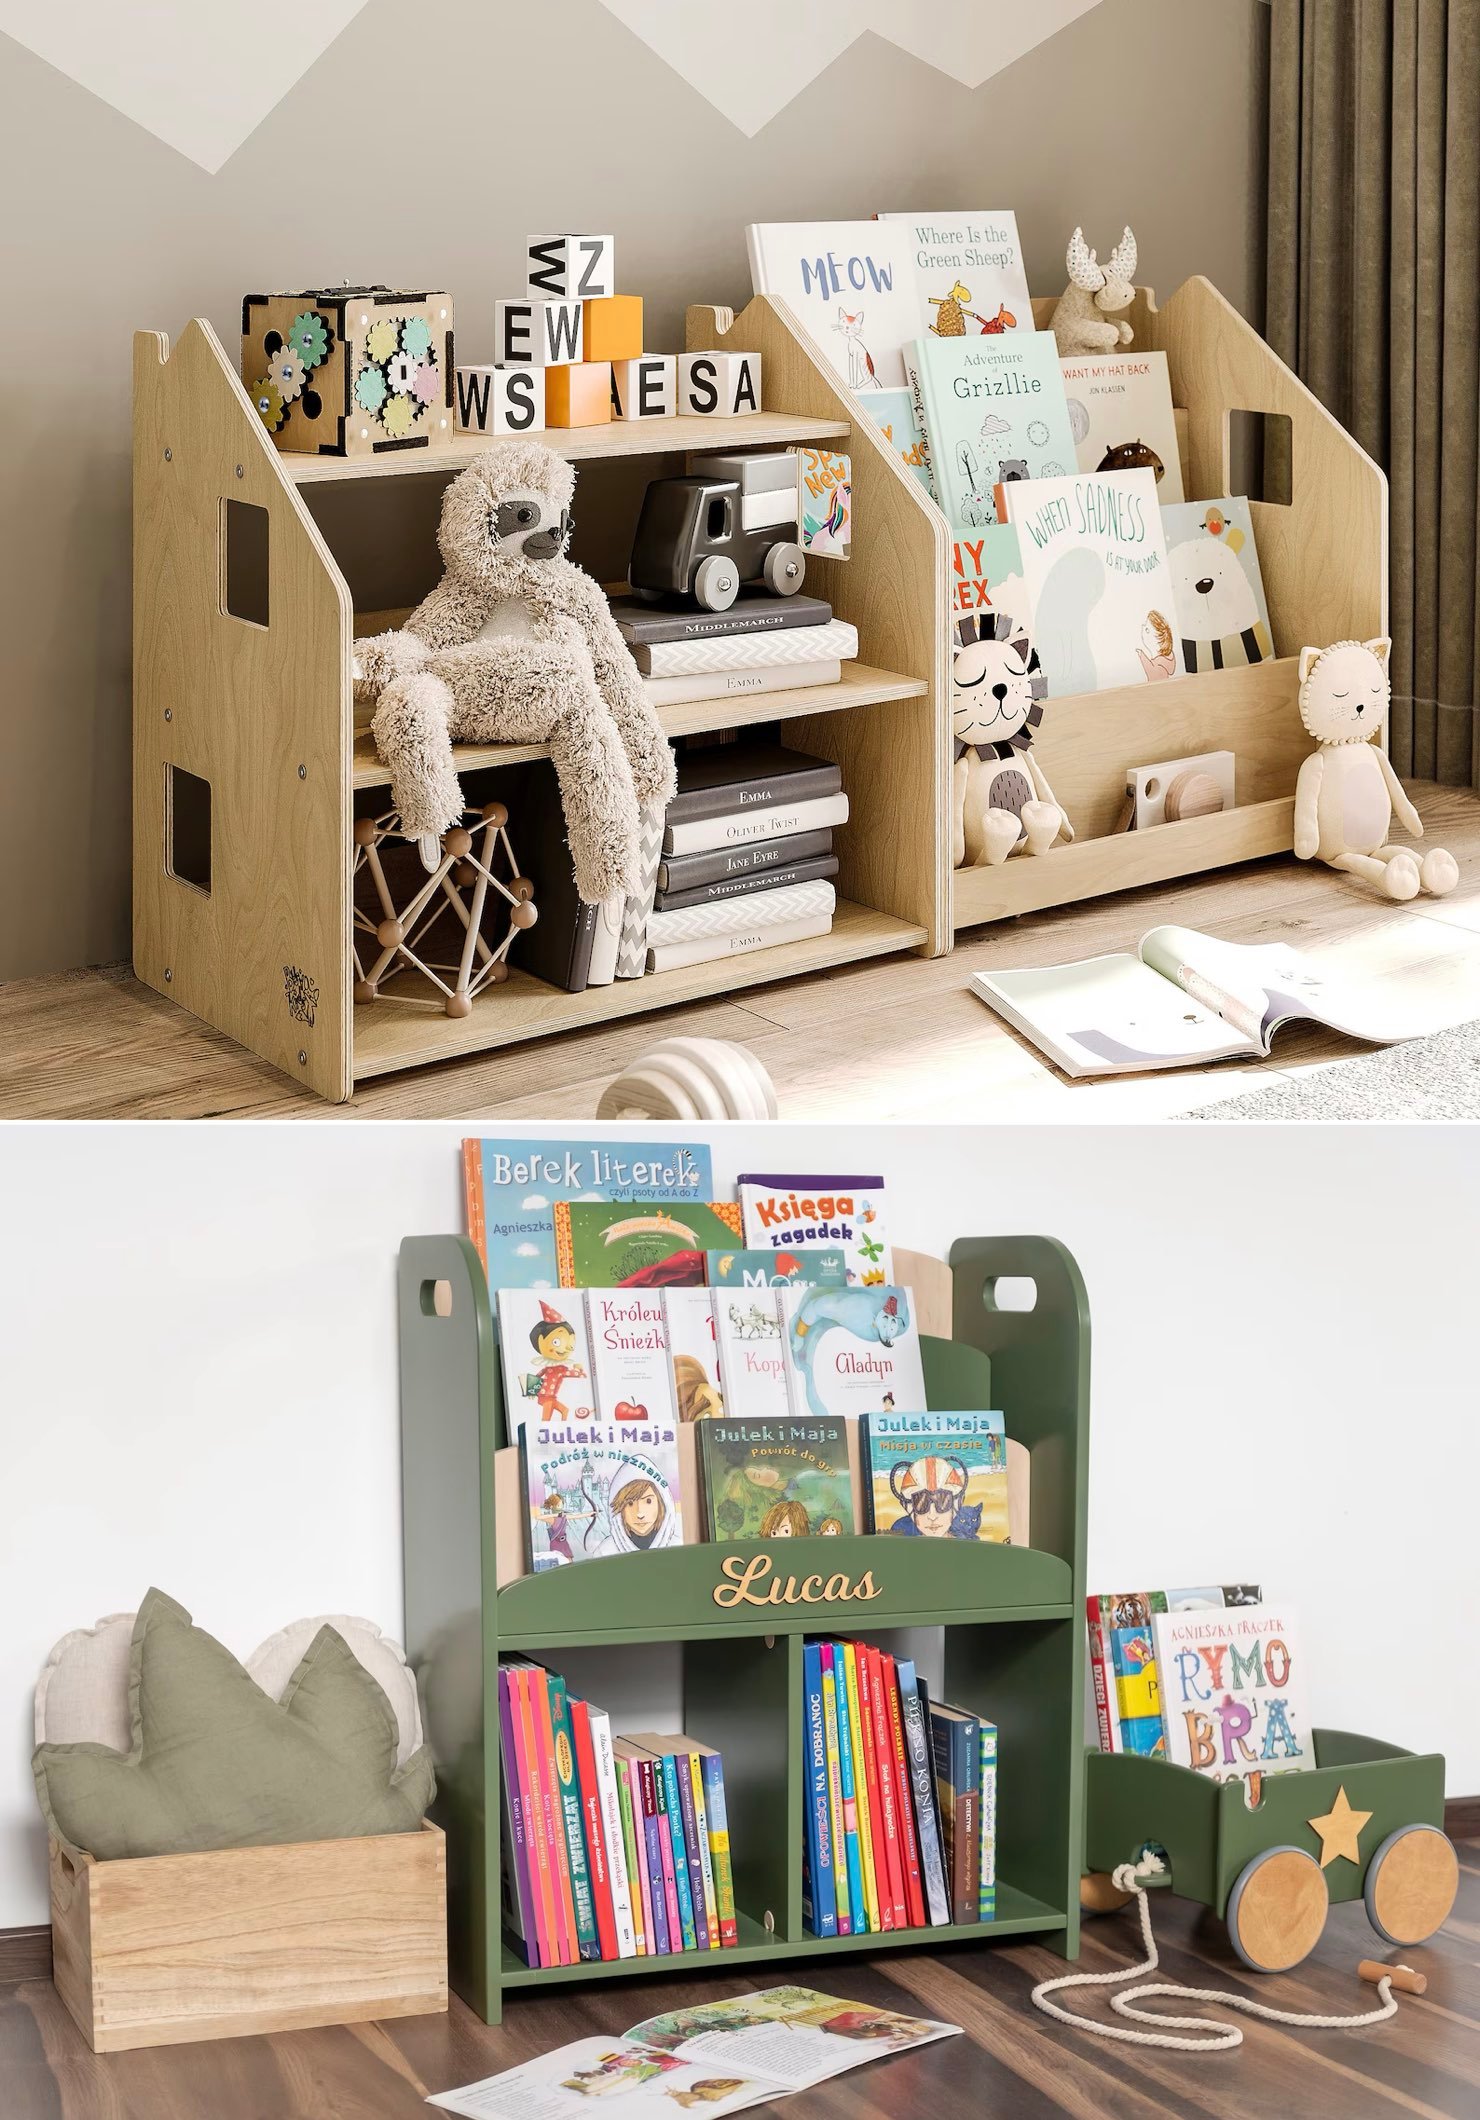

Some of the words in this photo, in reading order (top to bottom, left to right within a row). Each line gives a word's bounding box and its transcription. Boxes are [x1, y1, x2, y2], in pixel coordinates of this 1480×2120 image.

[915, 227, 963, 244] Where
[967, 226, 981, 242] Is
[985, 225, 1008, 242] the
[578, 241, 604, 296] Z
[917, 250, 961, 268] Green
[965, 247, 1014, 269] Sheep?
[801, 253, 893, 300] MEOW
[504, 306, 532, 362] E
[546, 305, 581, 361] W
[963, 353, 1023, 367] Adventure
[1063, 366, 1089, 379] WANT
[1091, 366, 1106, 377] MY
[1108, 364, 1126, 376] HAT
[1128, 363, 1151, 376] BACK
[639, 362, 665, 416] E
[689, 360, 718, 413] S
[733, 360, 757, 413] A
[953, 373, 1042, 399] Grizllie
[1089, 386, 1100, 395] JON
[1101, 385, 1126, 394] KLASSEN
[457, 371, 491, 430] W
[505, 373, 535, 430] S
[804, 462, 846, 499] New
[1025, 497, 1071, 549] WHEN
[1075, 483, 1145, 543] SADNESS
[1106, 551, 1113, 566] IS
[1114, 556, 1122, 570] AT
[1124, 556, 1144, 575] YOUR
[1143, 551, 1161, 573] DOOR
[684, 616, 784, 634] MIDDLEMARCH
[726, 677, 763, 690] EMMA
[739, 789, 772, 805] EMMA
[726, 820, 766, 839] OLIVER
[768, 815, 799, 832] TWIST
[726, 855, 750, 872] JANE
[752, 849, 779, 867] EYRE
[707, 872, 796, 897] MIDDLEMARCH
[729, 935, 763, 949] EMMA
[492, 1152, 583, 1189] Berek
[590, 1149, 699, 1187] literek
[609, 1187, 630, 1197] czyli
[633, 1188, 656, 1198] psoty
[658, 1188, 669, 1197] od
[671, 1189, 679, 1197] A
[680, 1188, 691, 1197] do
[693, 1189, 699, 1197] Z
[755, 1193, 854, 1228] Księga
[493, 1221, 553, 1237] Agnieszka
[770, 1222, 853, 1247] zagadek
[836, 1352, 893, 1379] Aladyn
[538, 1426, 602, 1445] Julek
[609, 1426, 614, 1443] i
[621, 1425, 675, 1446] Maja
[715, 1426, 774, 1442] Julek
[779, 1425, 784, 1441] i
[790, 1425, 838, 1443] Maja
[878, 1416, 932, 1432] Julek
[936, 1416, 941, 1431] i
[946, 1416, 990, 1433] Maja
[751, 1445, 797, 1458] Powrót
[800, 1449, 815, 1463] do
[880, 1440, 917, 1453] Misja
[920, 1441, 932, 1450] w
[935, 1438, 983, 1450] czasie
[540, 1447, 590, 1473] Podróż
[594, 1450, 604, 1458] w
[608, 1450, 669, 1489] nieznane
[712, 1554, 884, 1608] Lucas
[1171, 1624, 1233, 1642] AGNIESZKA
[1173, 1639, 1292, 1701] RYMO
[872, 1676, 881, 1714] Agnieszka
[1093, 1664, 1106, 1708] DZIECI
[810, 1693, 825, 1766] DOBRANOC
[876, 1715, 885, 1746] Frączek
[1182, 1697, 1303, 1770] BRA
[548, 1756, 558, 1792] Zwierzęta
[665, 1764, 674, 1779] Kto
[906, 1696, 923, 1763] PIĘKNO
[916, 1768, 932, 1825] KONIA
[531, 1771, 540, 1813] Rekordziści
[667, 1779, 675, 1808] pokocha
[814, 1772, 826, 1791] NA
[883, 1784, 889, 1794] na
[523, 1793, 531, 1815] Młode
[552, 1794, 562, 1830] zagrożone
[588, 1796, 597, 1821] Bajeczki
[606, 1792, 616, 1824] Mikołajek
[683, 1784, 693, 1822] uprowadzony
[525, 1816, 534, 1847] zwierzęta
[536, 1815, 544, 1836] wśród
[546, 1818, 555, 1845] kocięta
[670, 1809, 678, 1837] Psotkę?
[816, 1795, 830, 1867] OPOWIEŚCI
[884, 1797, 894, 1839] hulajnodze
[589, 1822, 599, 1846] naszego
[610, 1830, 620, 1854] słodkie
[687, 1823, 695, 1849] szczeniak
[538, 1839, 547, 1869] zwierząt
[556, 1832, 569, 1877] wyginięciem
[593, 1847, 605, 1882] dzieciństwa
[612, 1856, 624, 1888] przekąski
[678, 1877, 687, 1892] Holly
[575, 1878, 590, 1932] ŚWIAT
